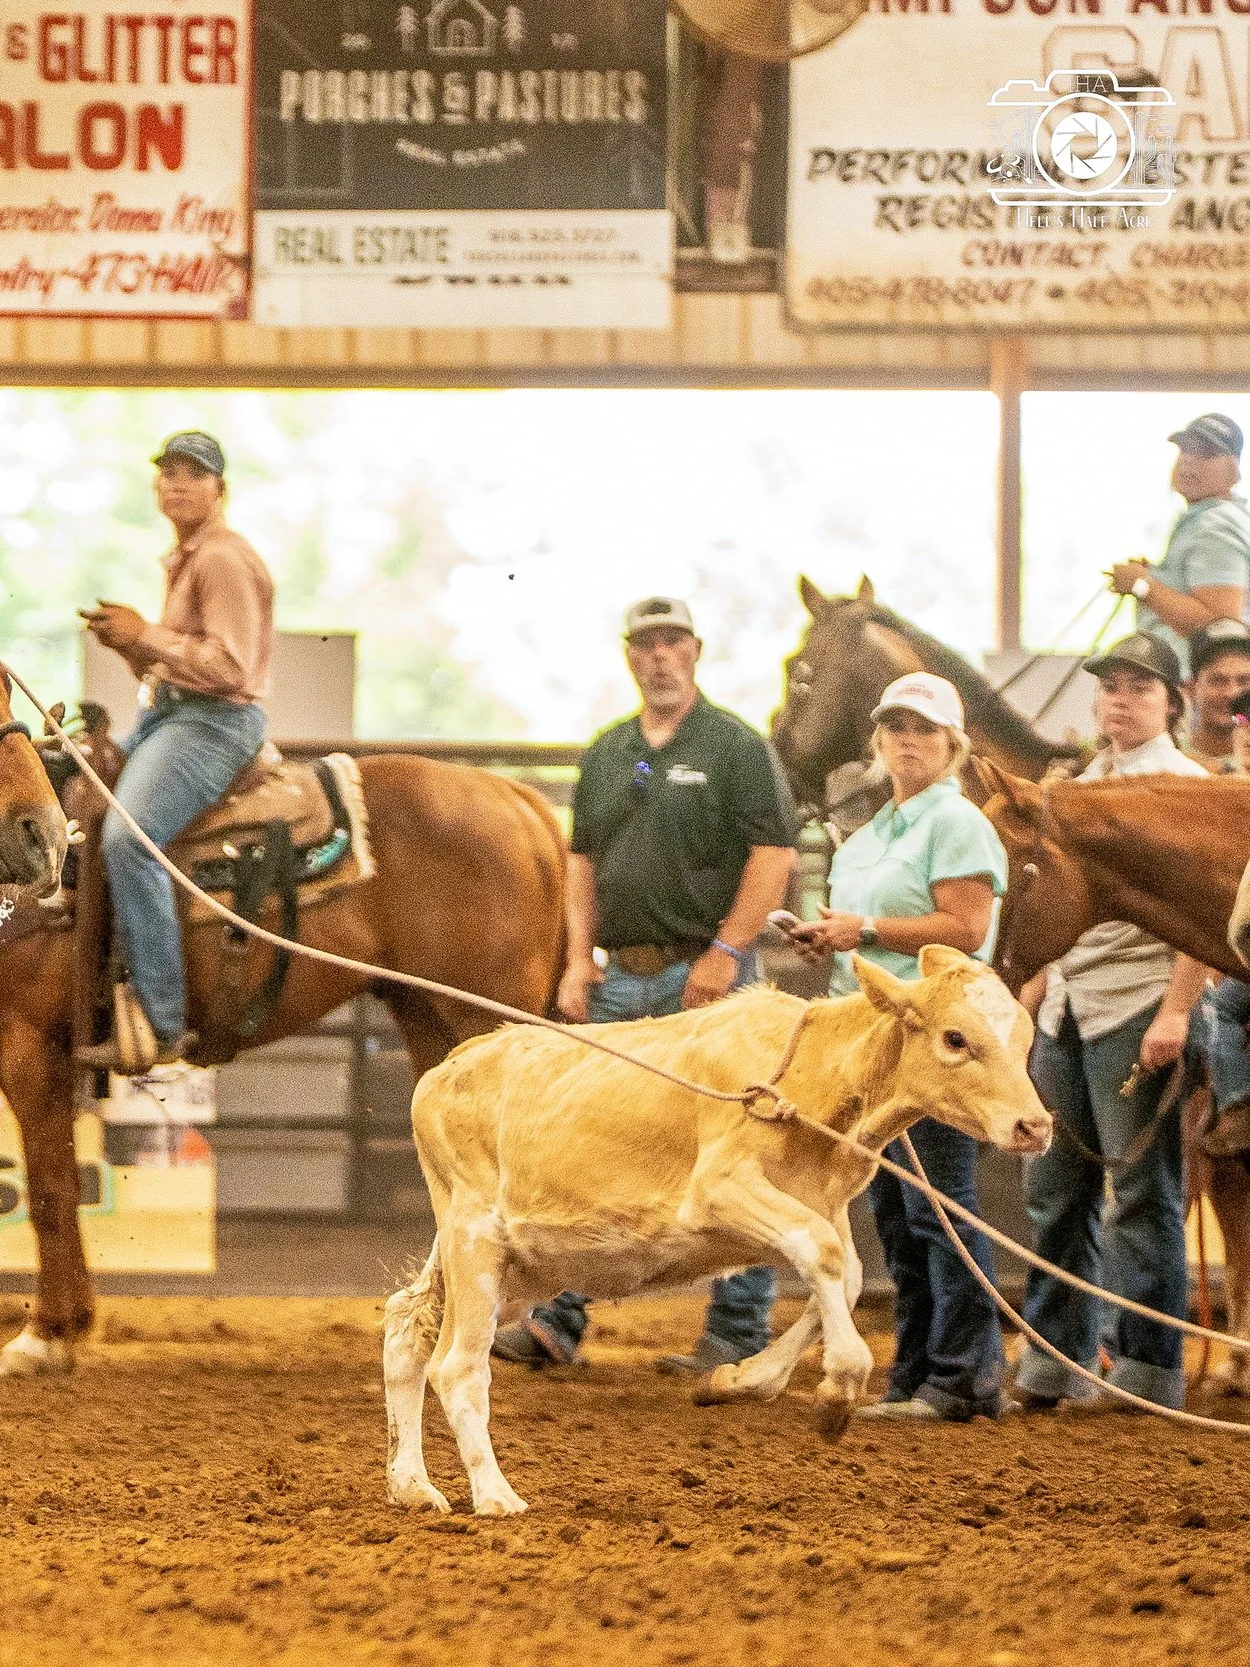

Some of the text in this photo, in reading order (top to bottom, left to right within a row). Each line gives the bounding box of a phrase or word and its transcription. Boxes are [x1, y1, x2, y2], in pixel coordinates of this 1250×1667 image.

[39, 14, 238, 84] GLITTER
[279, 69, 436, 125] PORCHES
[475, 69, 648, 125] PASTURES
[274, 226, 451, 266] REAL ESTATE
[962, 239, 1109, 271] CONTACT
